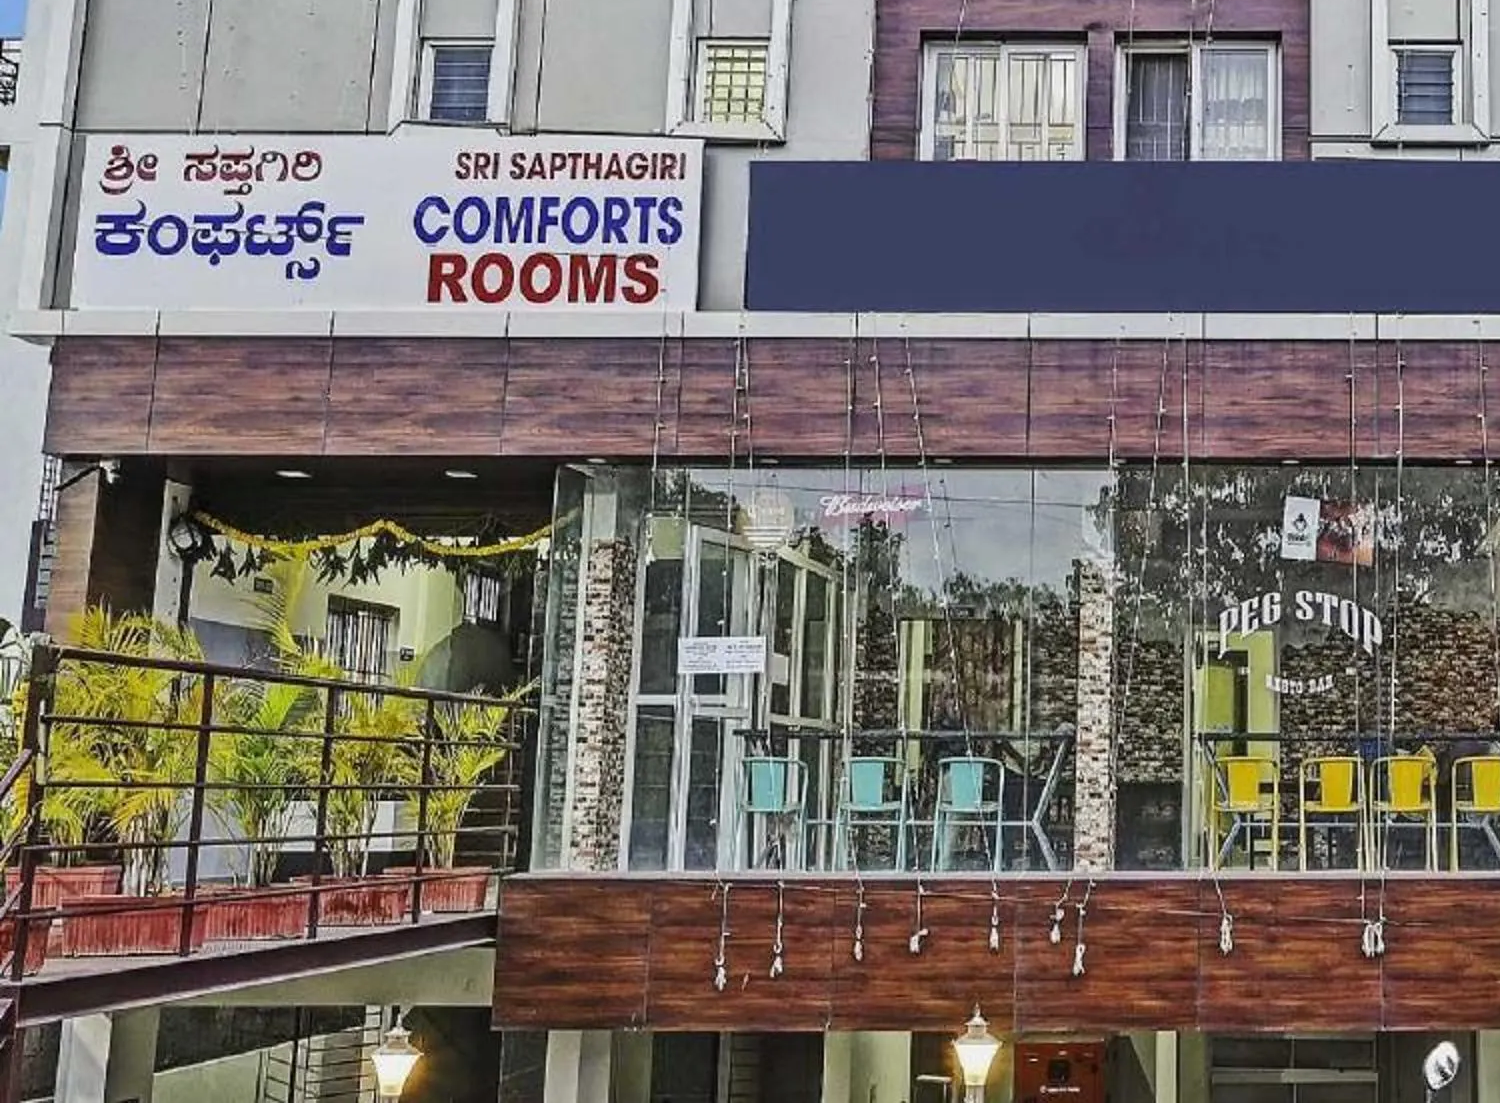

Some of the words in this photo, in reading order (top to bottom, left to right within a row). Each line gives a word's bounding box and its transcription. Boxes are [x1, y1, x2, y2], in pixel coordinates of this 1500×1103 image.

[99, 144, 159, 195] ಶ್ರೀ
[183, 144, 323, 196] ಸಪ್ತಗಿರಿ
[454, 152, 501, 181] SRI
[509, 152, 688, 181] SAPTHAGIRI
[413, 196, 684, 246] COMFORTS
[426, 252, 660, 305] ROOMS
[1217, 591, 1282, 660] PEG
[1295, 589, 1384, 658] STOP
